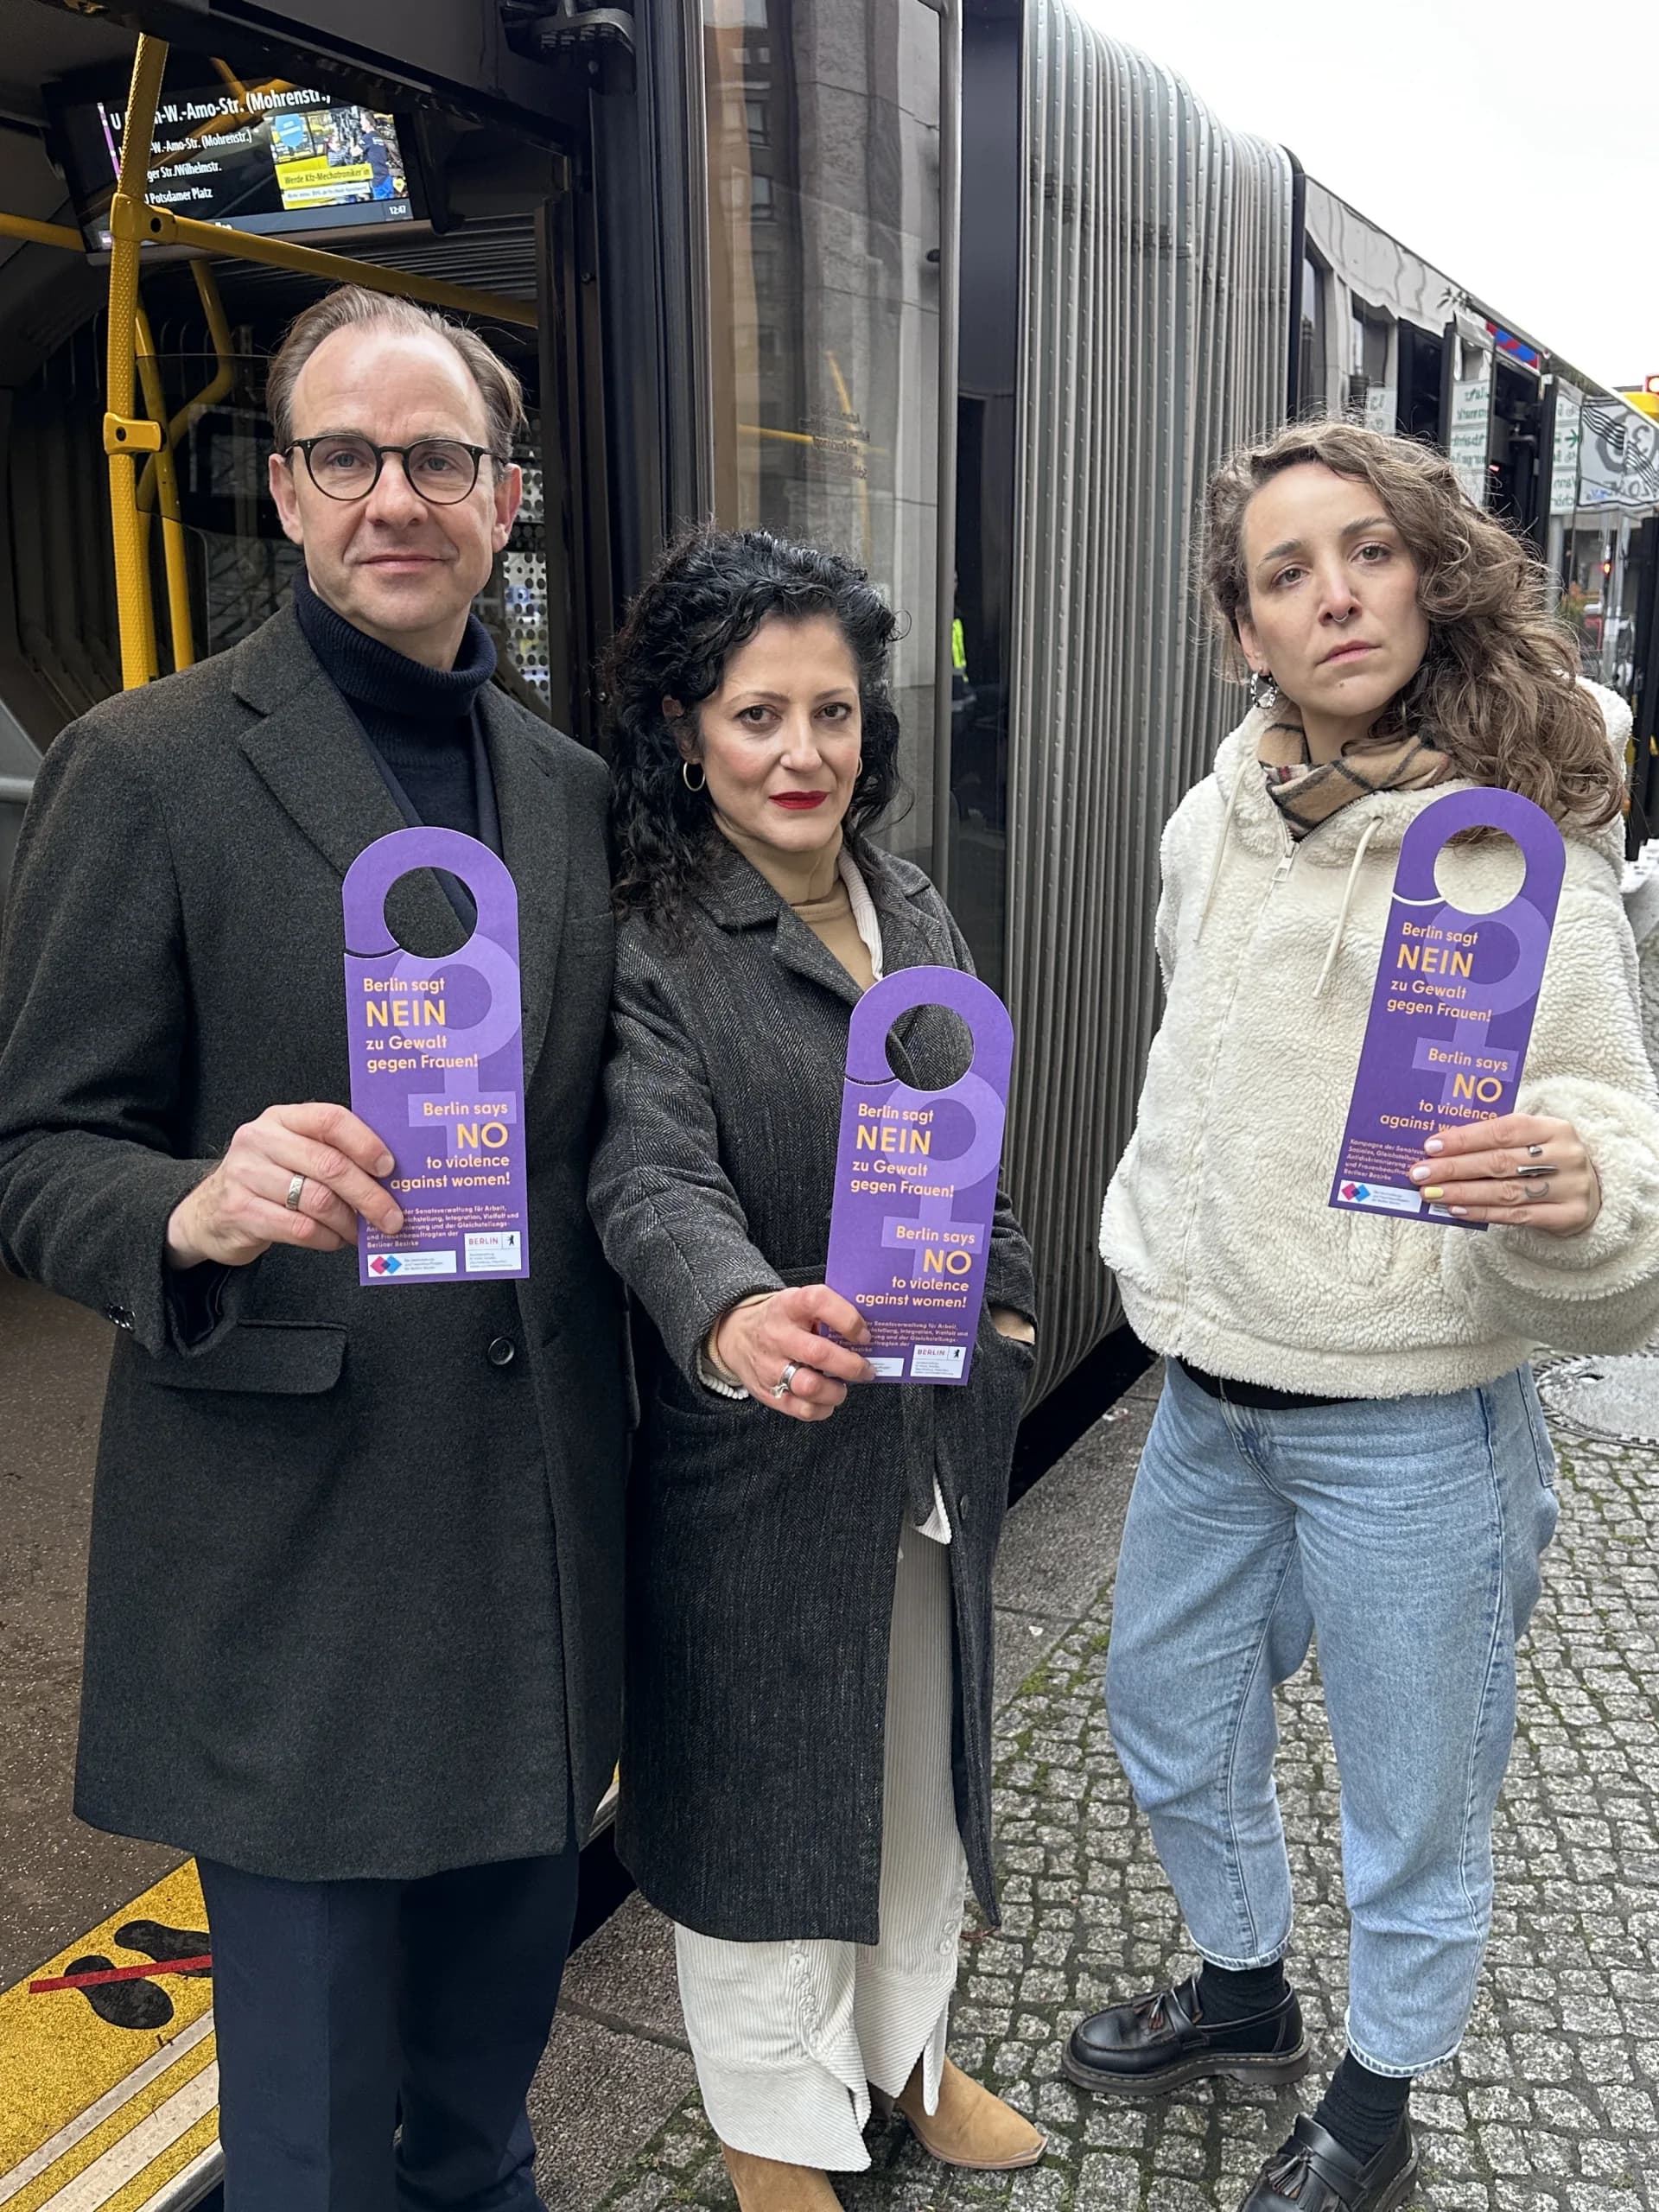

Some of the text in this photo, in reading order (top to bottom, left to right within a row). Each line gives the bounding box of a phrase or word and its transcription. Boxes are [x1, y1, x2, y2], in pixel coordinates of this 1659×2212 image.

[110, 112, 122, 130] U
[201, 129, 253, 149] (Mohrenstr.)
[150, 190, 191, 204] Potsdamer
[191, 187, 213, 200] Platz
[1402, 922, 1478, 947] Berlin sagt
[1396, 944, 1474, 978] NEIN
[363, 977, 445, 995] Berlin sagt
[1390, 980, 1467, 1000] zu Gewalt
[365, 999, 446, 1027] NEIN
[1387, 999, 1492, 1022] gegen Frauen!
[365, 1035, 448, 1050] zu Gewalt
[367, 1053, 479, 1073] gegen Frauen!
[1428, 1047, 1509, 1073] Berlin says
[1452, 1072, 1503, 1103] NO
[423, 1102, 508, 1117] Berlin says
[858, 1103, 933, 1125] Berlin sagt
[1419, 1099, 1497, 1120] to violence
[1380, 1114, 1435, 1132] against
[457, 1122, 509, 1149] NO
[856, 1125, 931, 1155] NEIN
[426, 1154, 510, 1169] to violence
[853, 1160, 928, 1177] zu Gewalt
[390, 1172, 511, 1192] against women!
[850, 1179, 955, 1198] gegen Frauen!
[896, 1225, 976, 1246] Berlin says
[923, 1249, 972, 1275] NO
[892, 1275, 969, 1292] to violence
[855, 1293, 967, 1308] against women!
